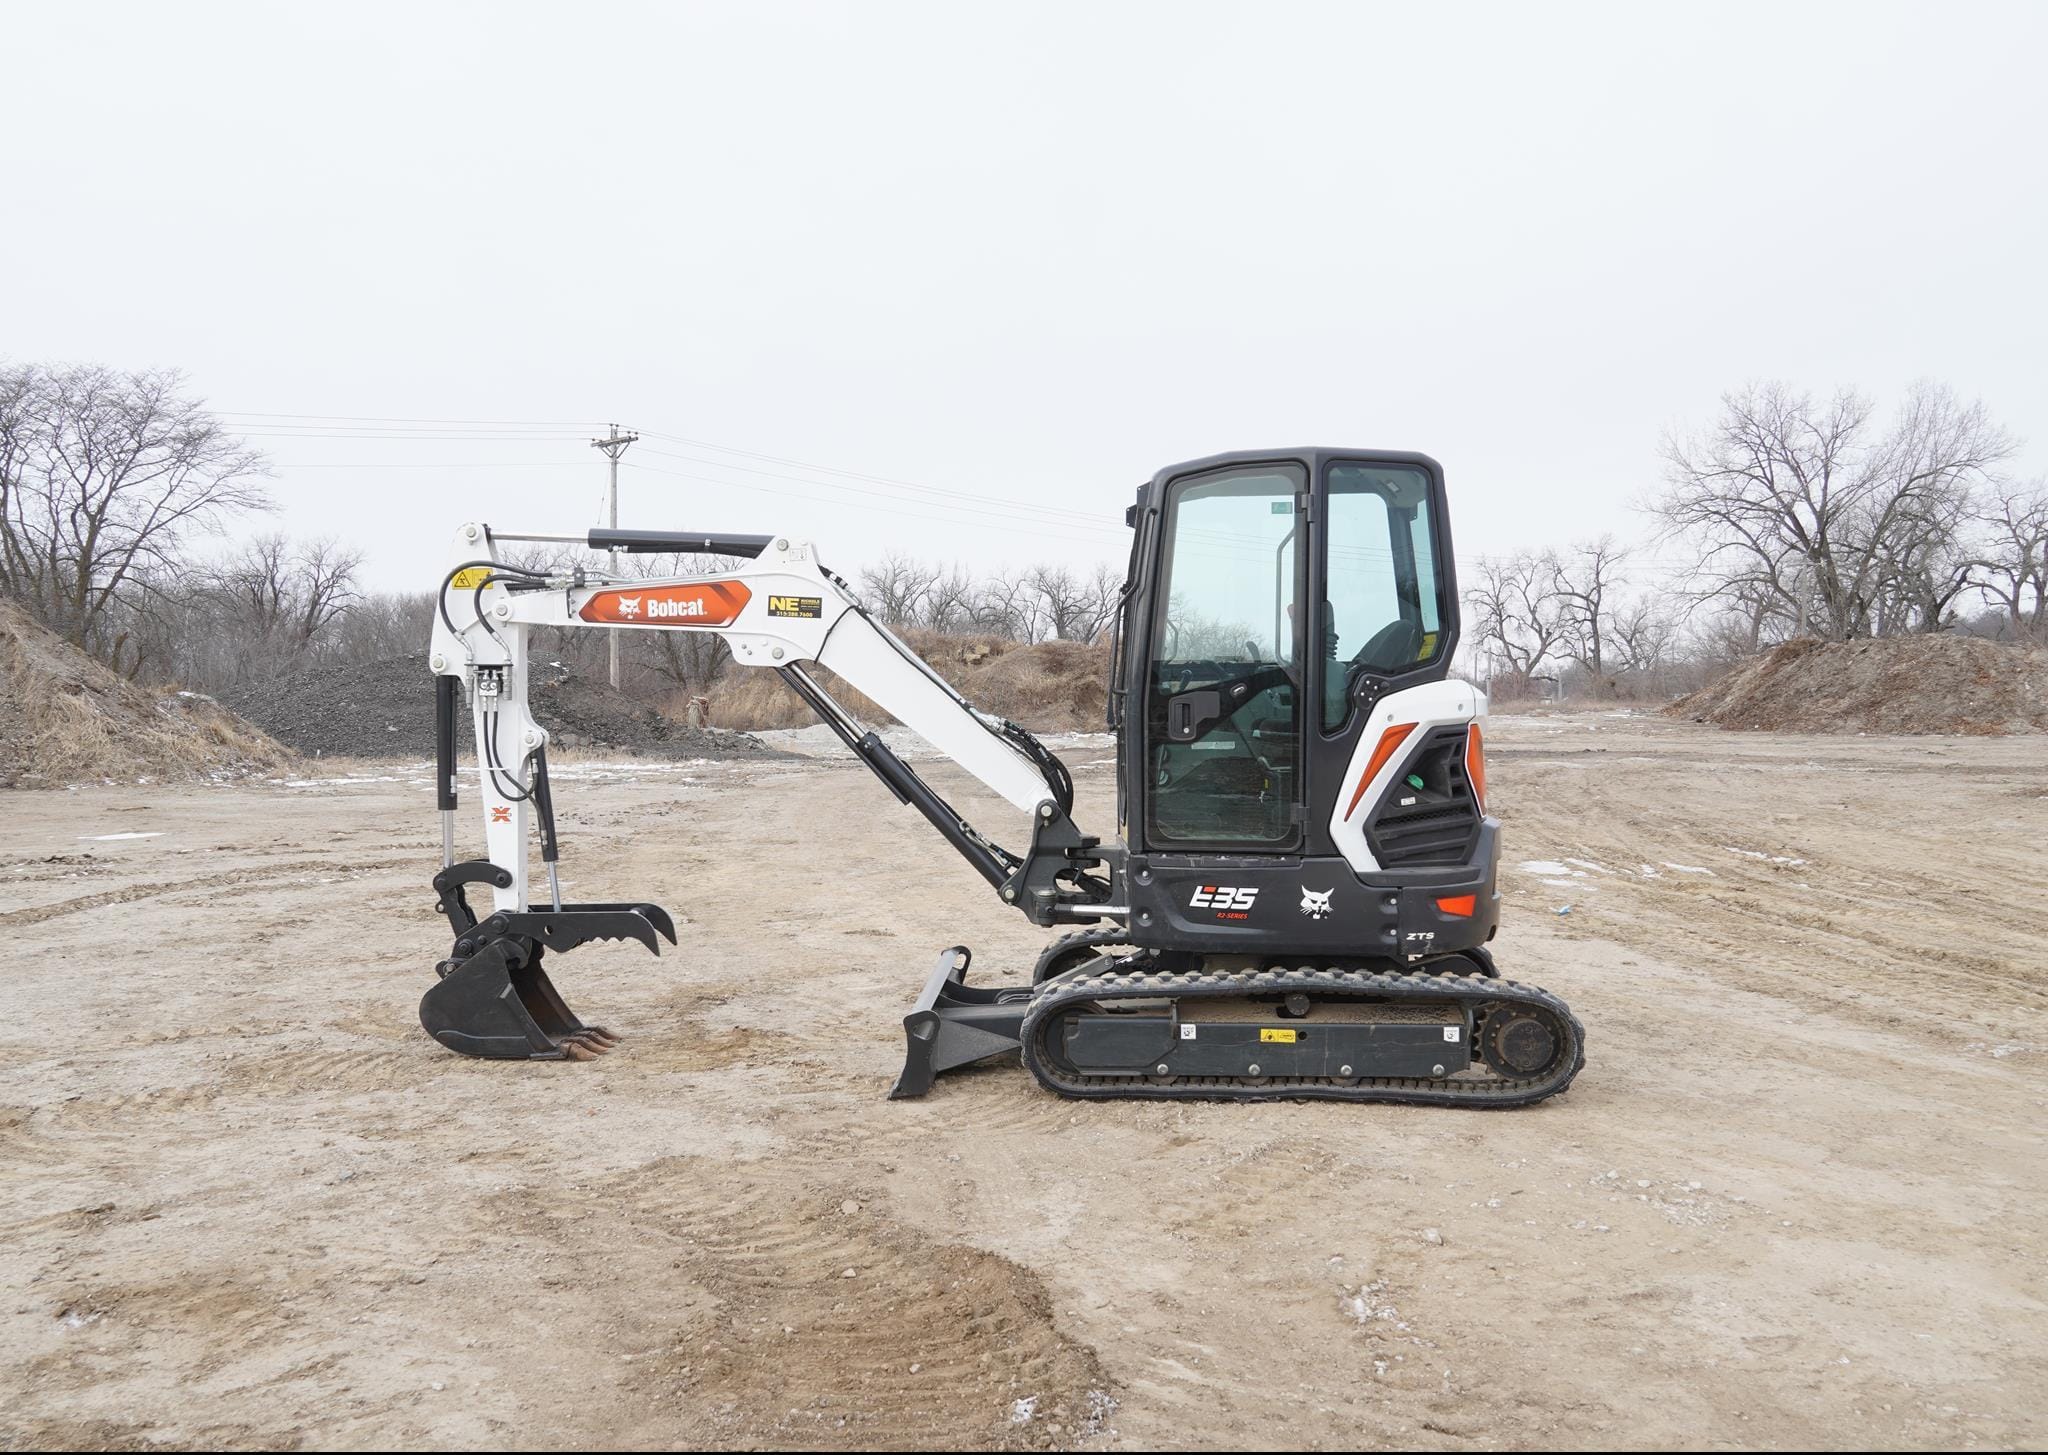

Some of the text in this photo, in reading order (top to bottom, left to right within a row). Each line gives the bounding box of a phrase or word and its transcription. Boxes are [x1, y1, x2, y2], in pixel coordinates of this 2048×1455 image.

[647, 599, 704, 617] Bobcat
[770, 597, 799, 611] NE
[1189, 886, 1259, 910] E35
[1406, 932, 1435, 940] ZTS
